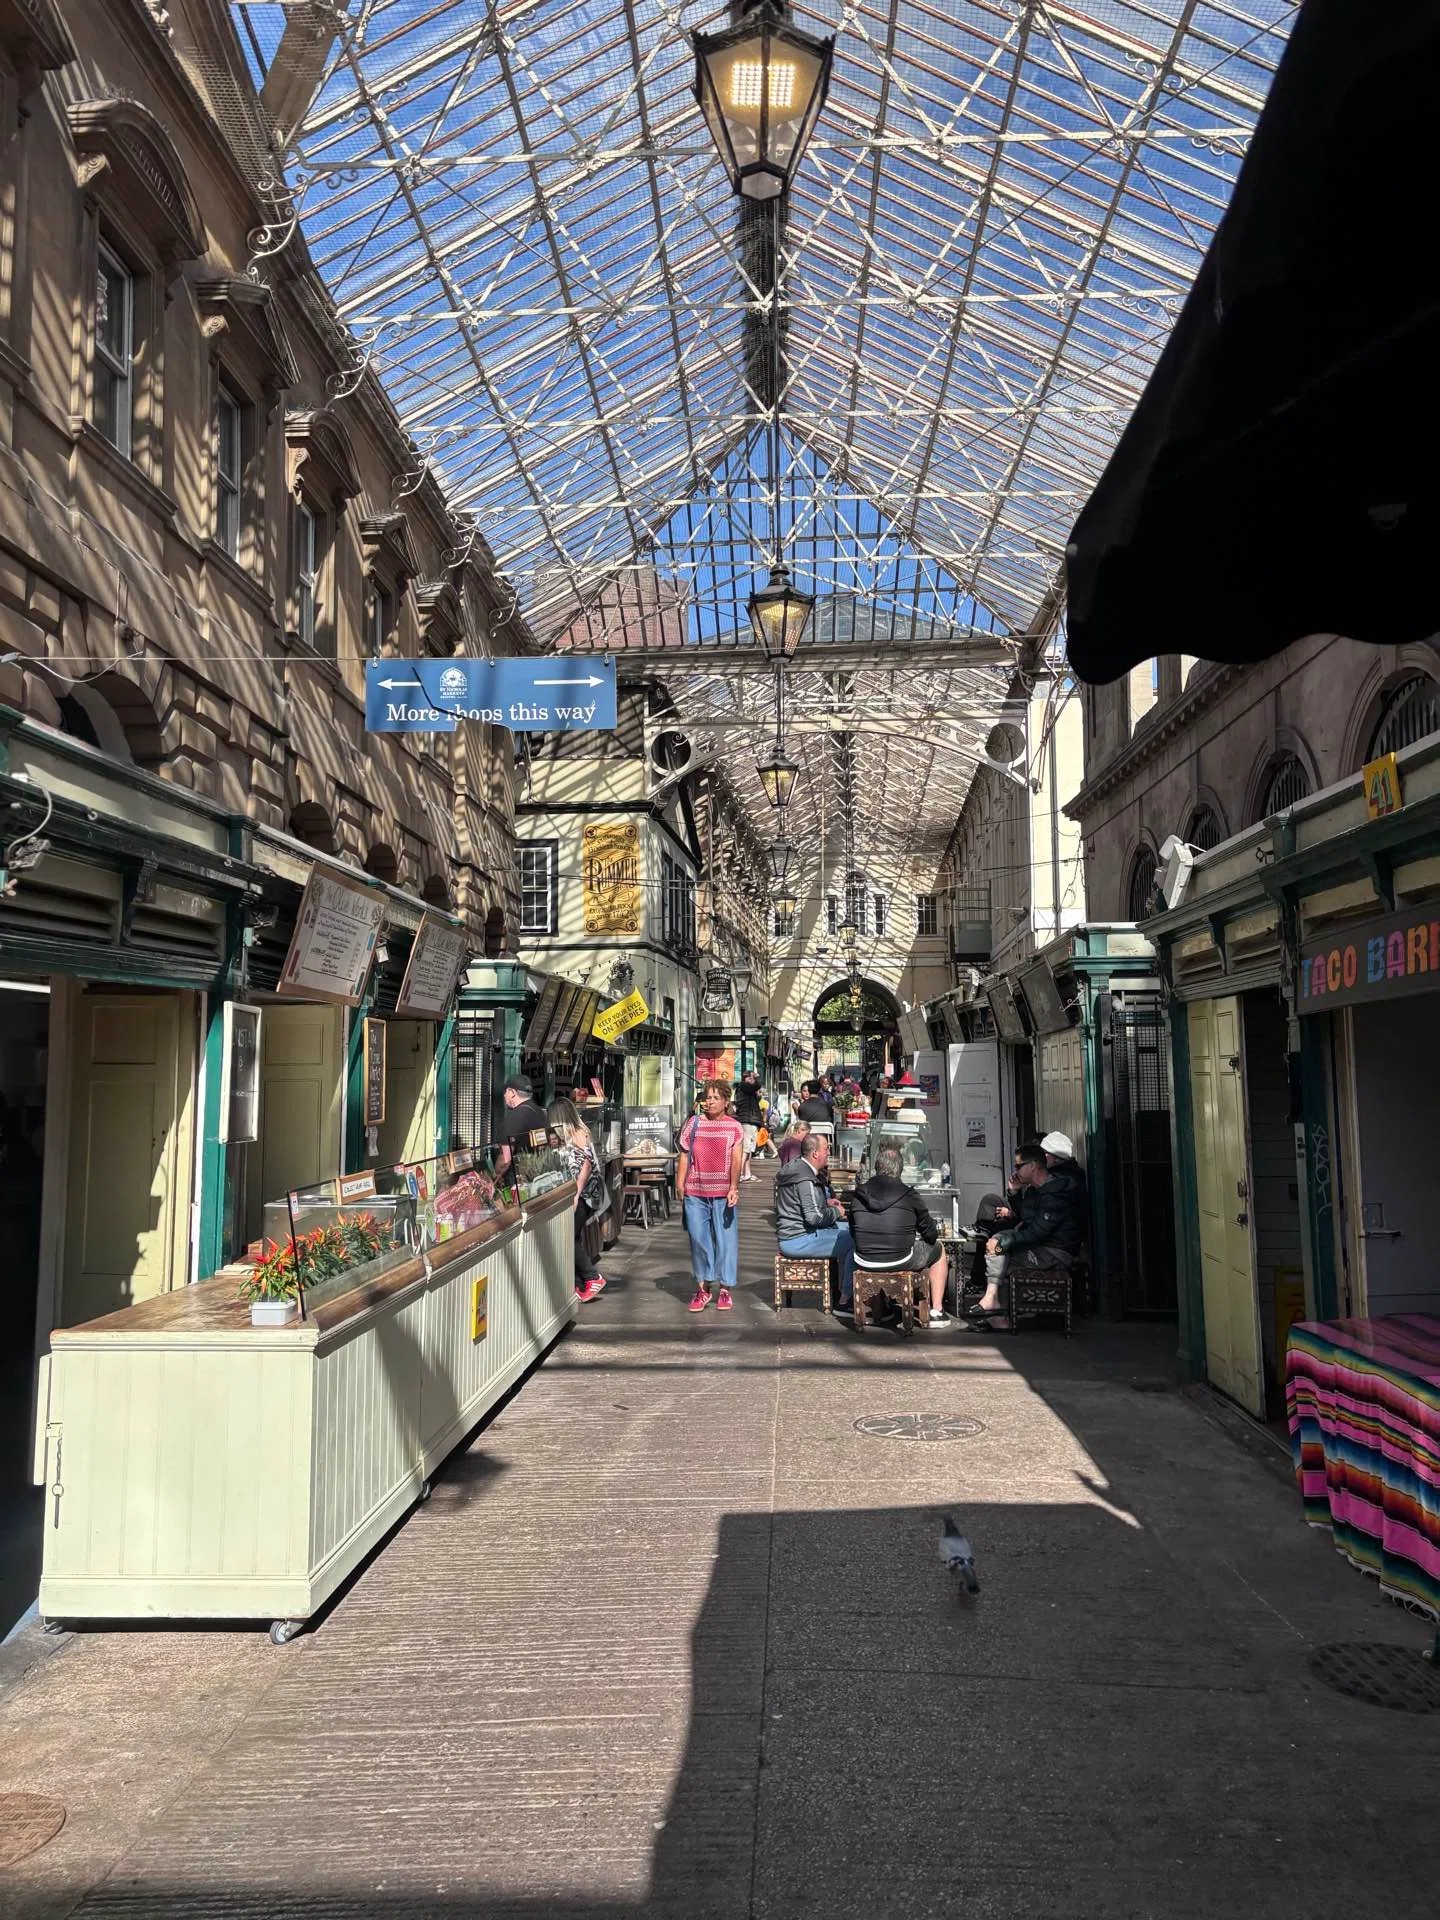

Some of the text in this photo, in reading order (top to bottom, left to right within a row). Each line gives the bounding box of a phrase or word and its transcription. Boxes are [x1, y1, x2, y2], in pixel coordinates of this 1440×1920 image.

[387, 703, 596, 724] More hops this way
[1370, 767, 1393, 812] 41
[585, 857, 637, 893] RUMMER
[1301, 945, 1357, 998] TACO
[598, 1001, 641, 1028] KEEP YOUR EYES
[602, 1007, 645, 1035] ON THE PIES
